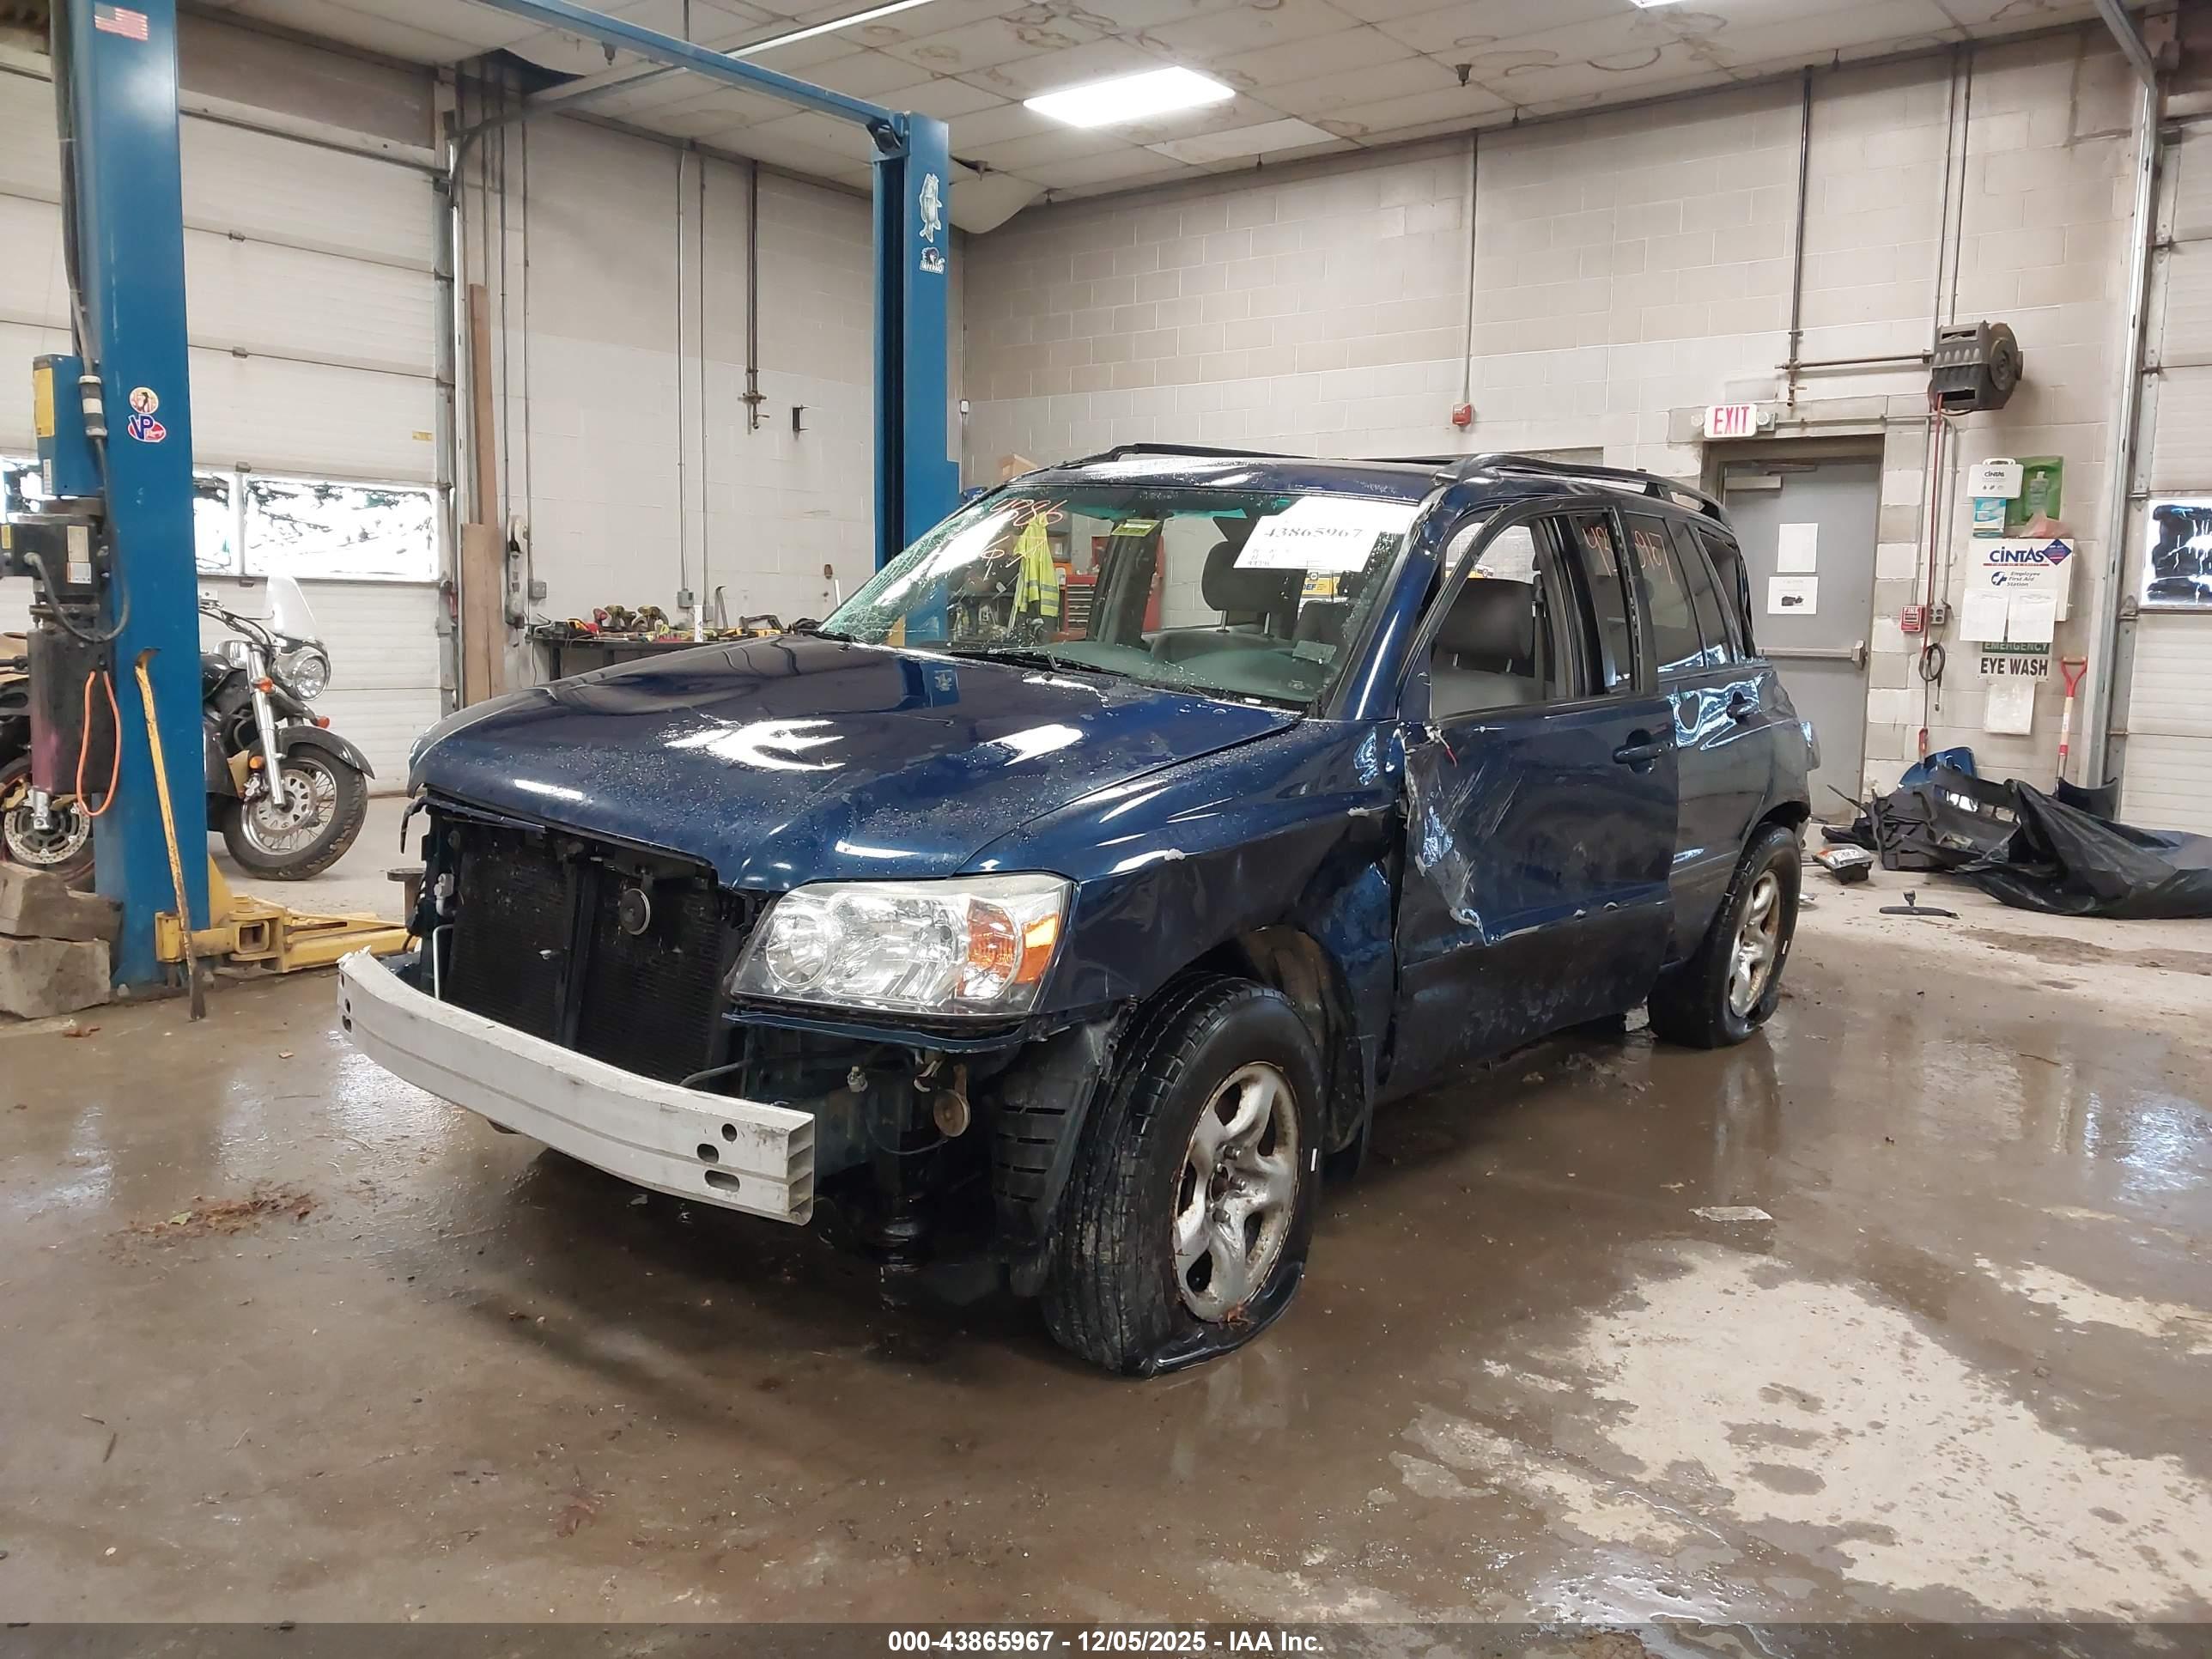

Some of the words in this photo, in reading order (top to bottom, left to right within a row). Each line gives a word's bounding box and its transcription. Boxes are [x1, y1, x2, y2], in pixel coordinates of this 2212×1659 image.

[128, 415, 155, 440] VP
[1713, 406, 1750, 435] EXIT
[1980, 657, 2006, 675] EYE
[2009, 658, 2049, 677] WASH
